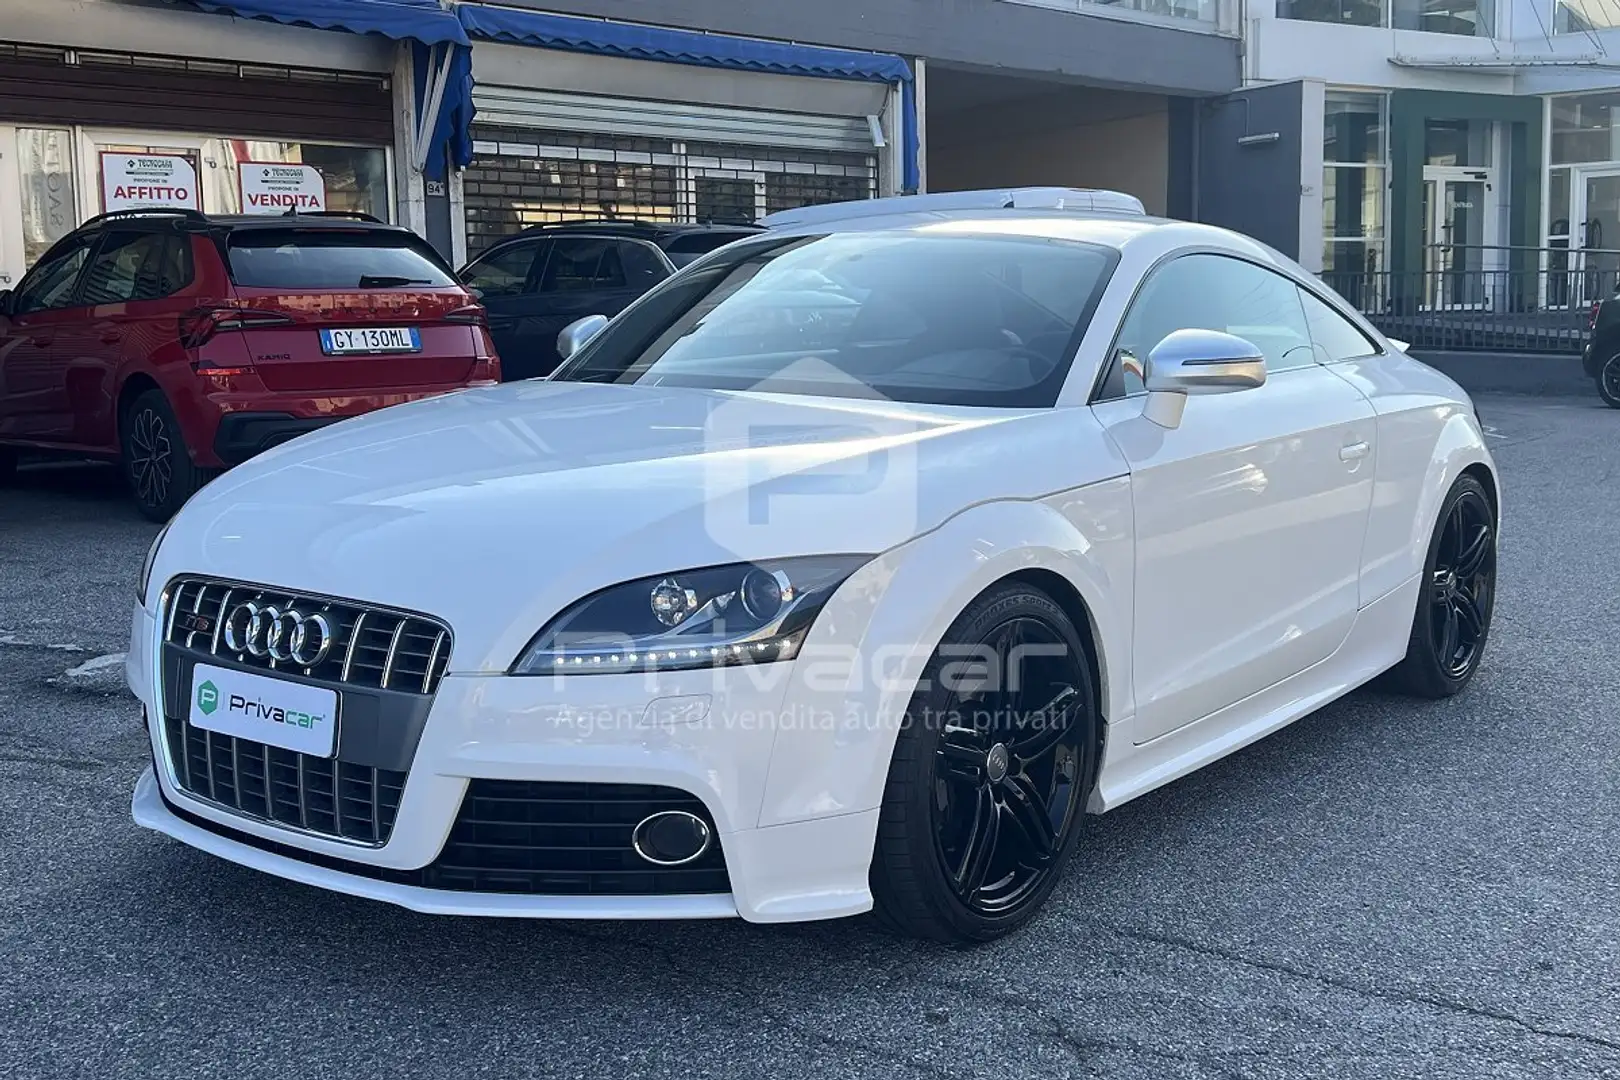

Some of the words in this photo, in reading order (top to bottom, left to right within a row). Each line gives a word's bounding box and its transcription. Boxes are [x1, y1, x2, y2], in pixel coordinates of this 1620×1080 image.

[113, 186, 188, 200] AFFITTO
[248, 194, 320, 208] VENDITA
[334, 331, 353, 348] GY
[361, 330, 410, 347] 130ML
